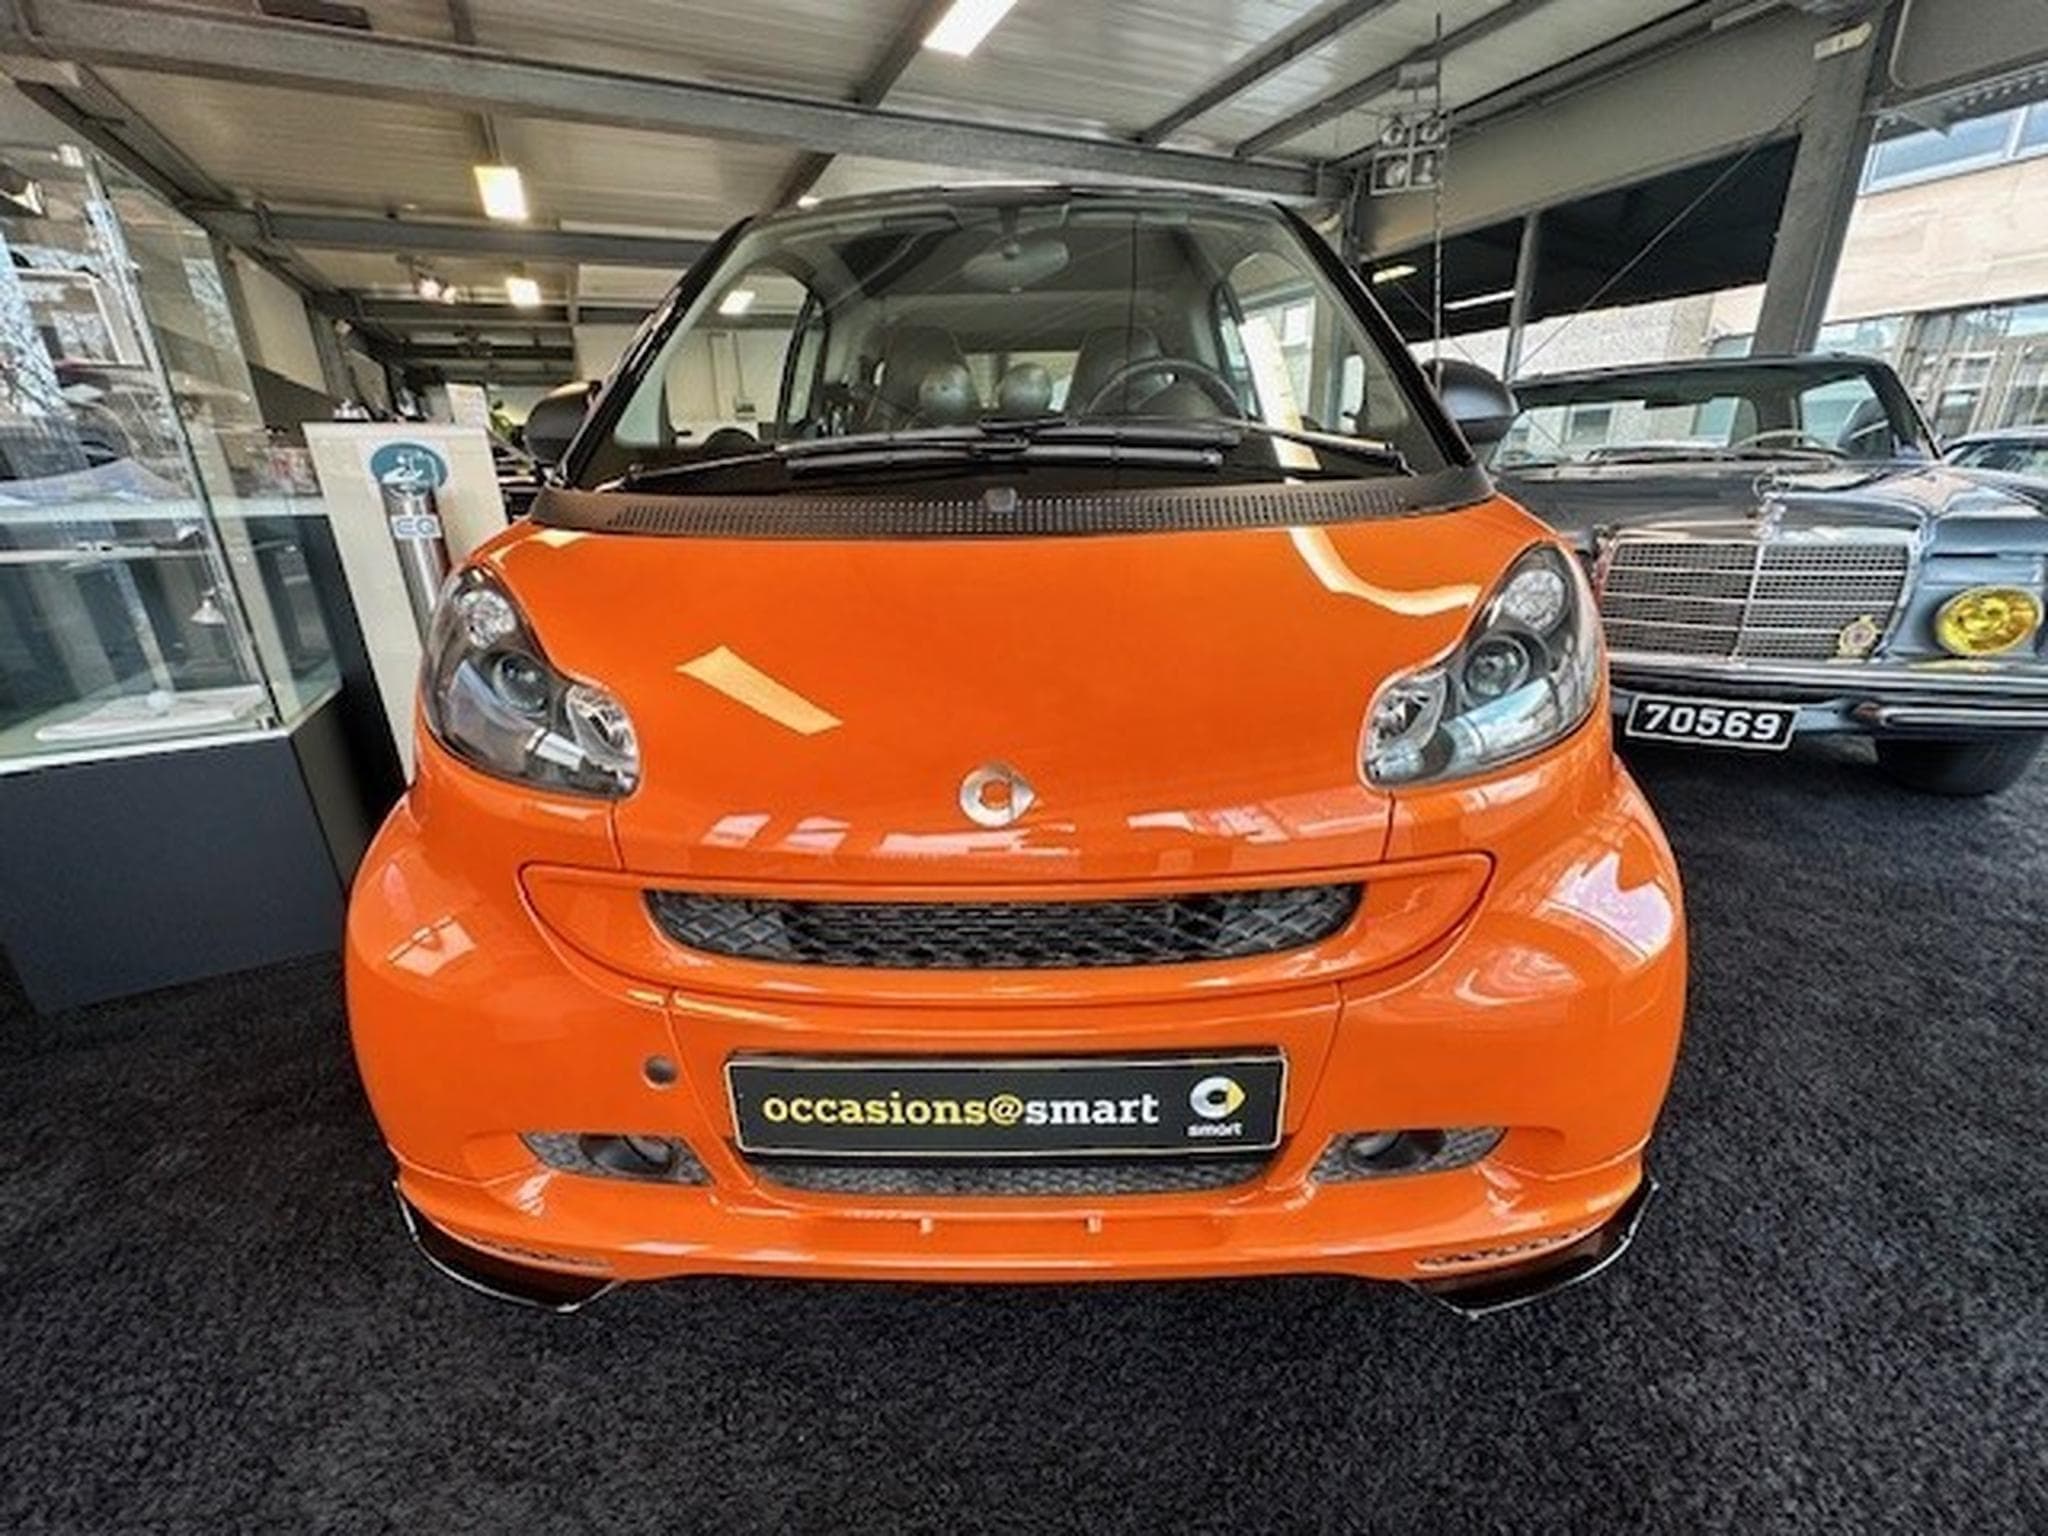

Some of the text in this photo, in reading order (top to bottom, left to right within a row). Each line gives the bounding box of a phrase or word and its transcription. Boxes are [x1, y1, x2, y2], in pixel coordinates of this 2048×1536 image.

[1645, 703, 1781, 741] 70569
[763, 1090, 1159, 1125] occasions@smart
[1187, 1122, 1243, 1137] smart
